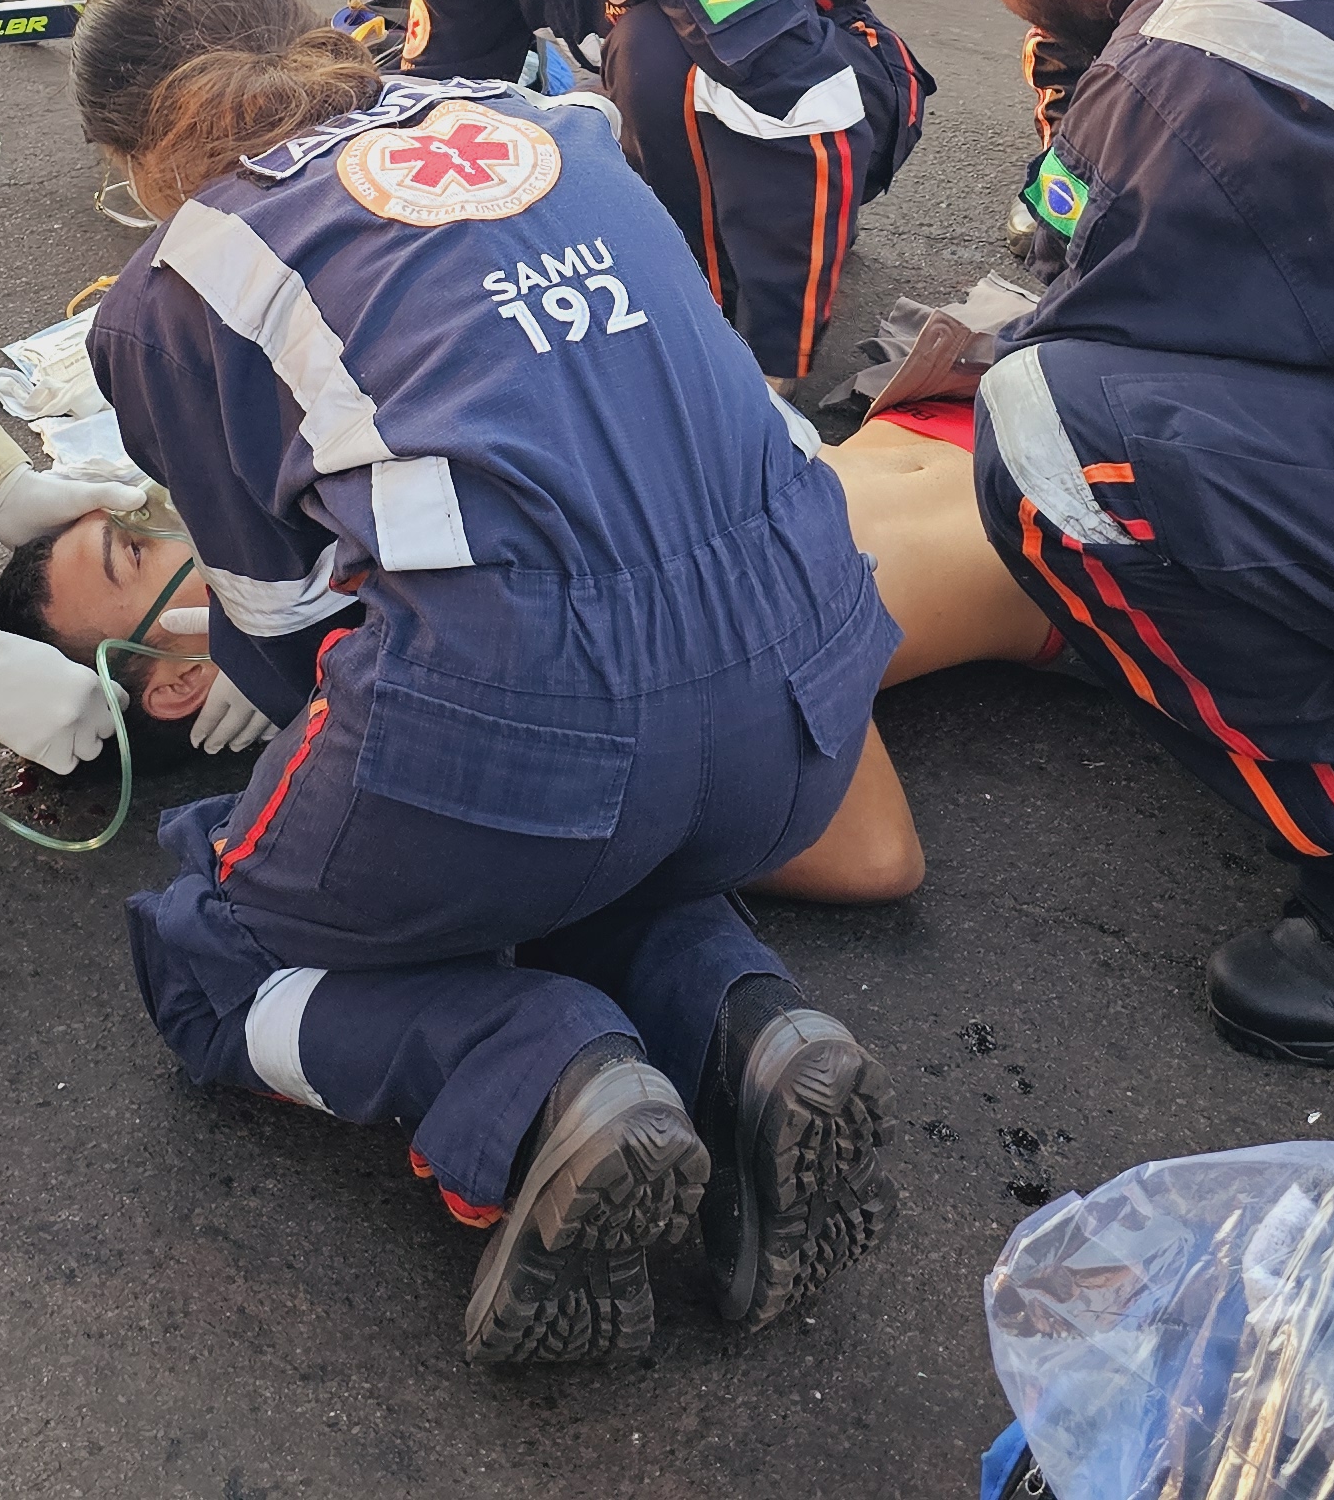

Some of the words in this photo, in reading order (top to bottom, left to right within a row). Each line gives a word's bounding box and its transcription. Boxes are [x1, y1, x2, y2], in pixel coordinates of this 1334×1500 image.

[525, 182, 541, 197] DE
[482, 236, 615, 302] SAMU
[497, 274, 649, 354] 192
